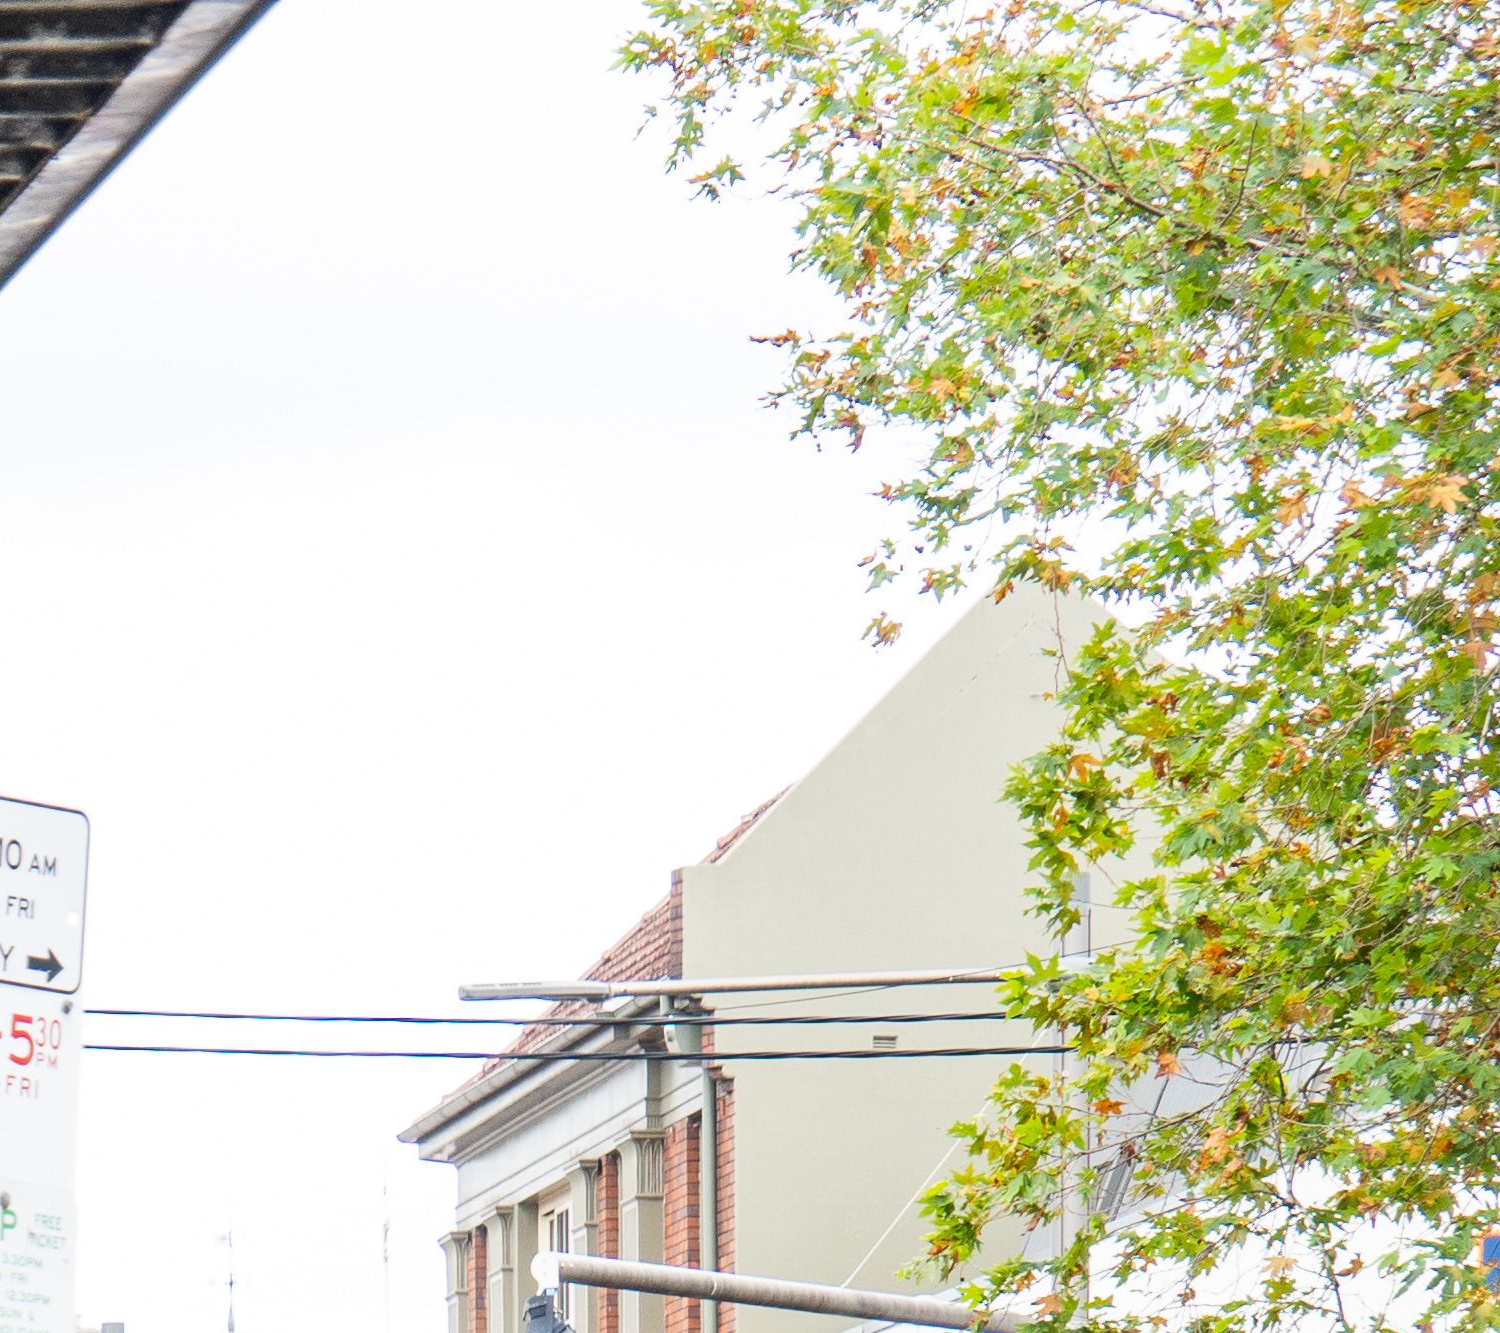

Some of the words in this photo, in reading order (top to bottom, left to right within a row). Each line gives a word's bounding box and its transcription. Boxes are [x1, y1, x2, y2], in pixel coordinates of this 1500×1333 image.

[28, 854, 57, 877] AM
[6, 896, 35, 919] FRI
[34, 1213, 62, 1231] FREE
